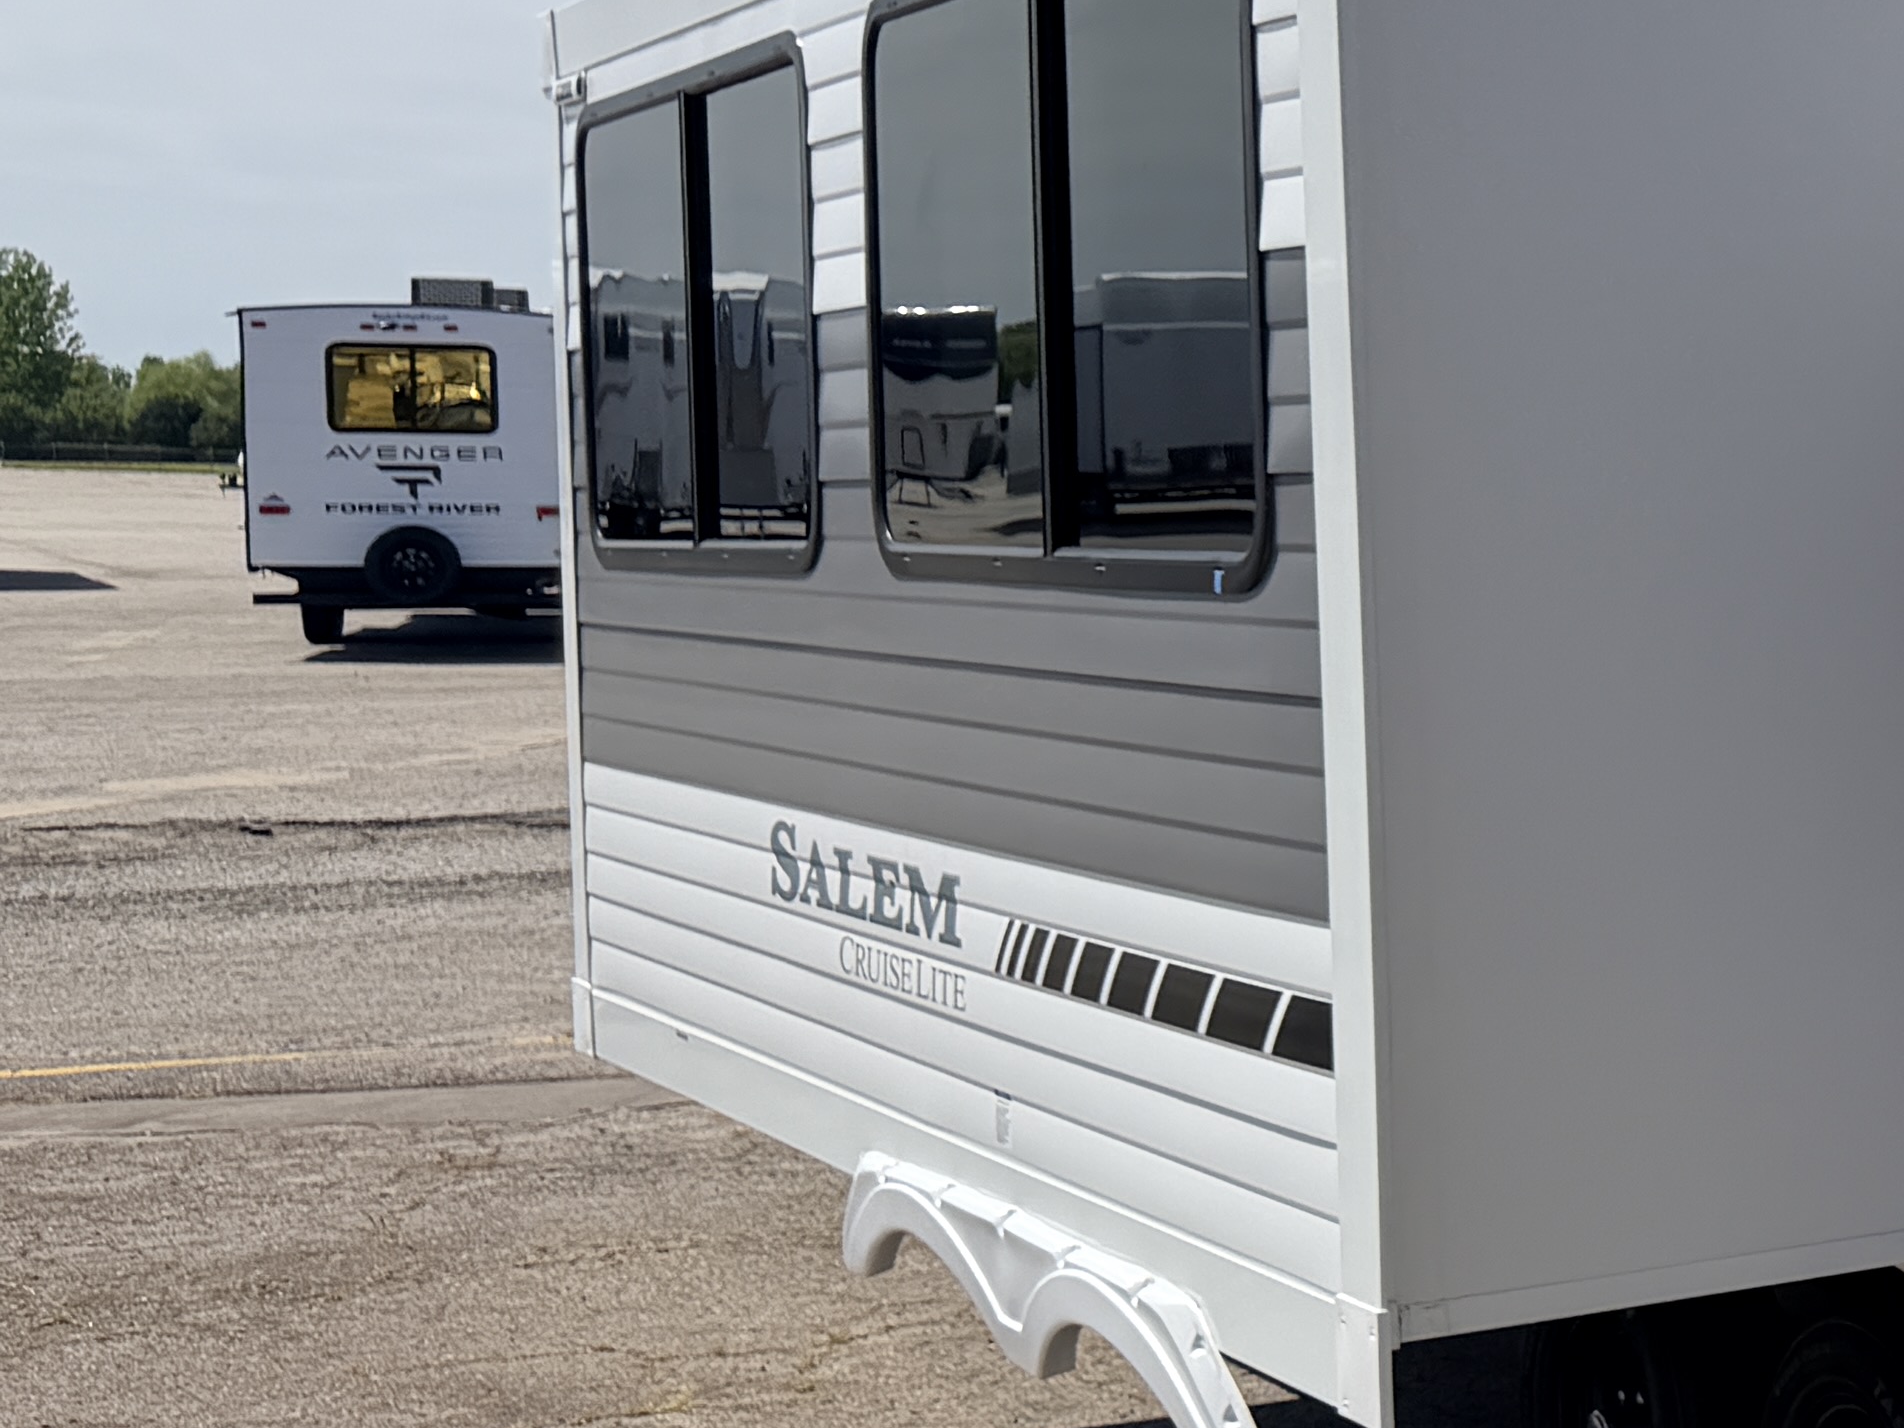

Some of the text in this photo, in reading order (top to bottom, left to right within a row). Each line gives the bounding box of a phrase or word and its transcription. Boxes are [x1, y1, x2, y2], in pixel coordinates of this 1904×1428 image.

[325, 444, 504, 463] AVENGER
[325, 501, 501, 517] FOREST RIVER
[770, 819, 963, 949] SALEM
